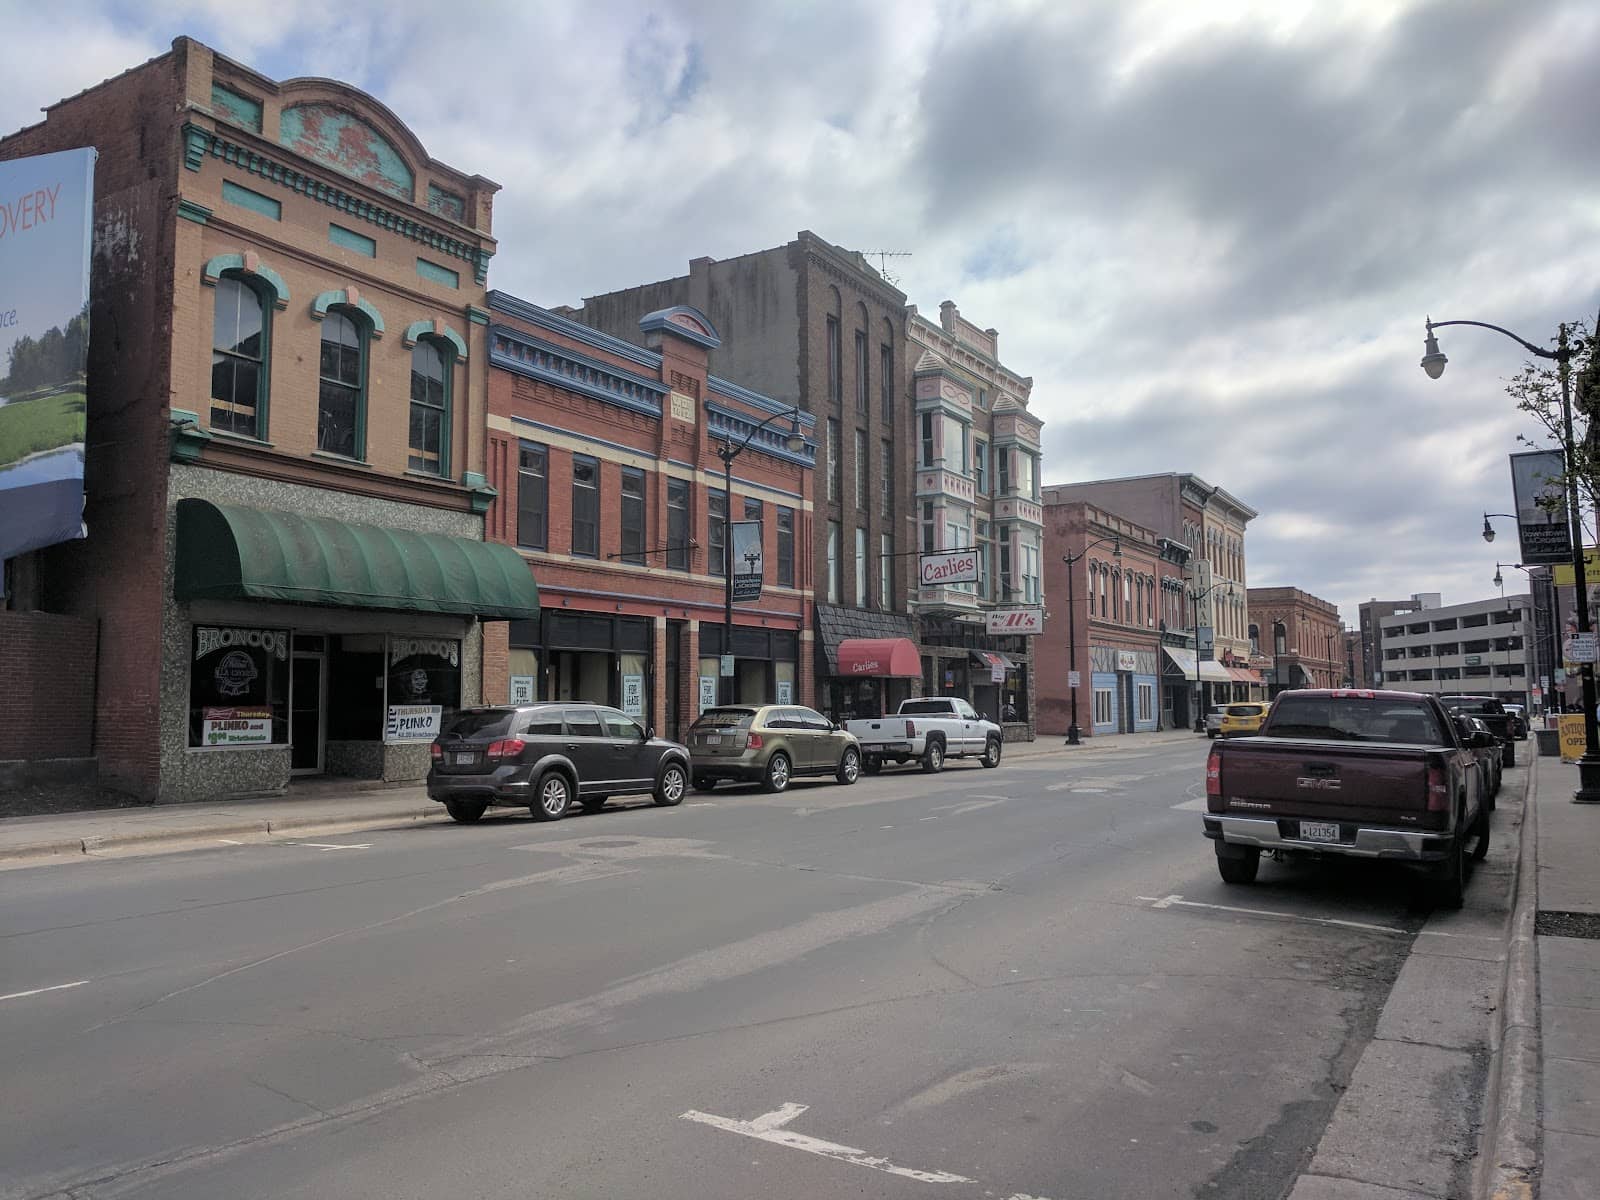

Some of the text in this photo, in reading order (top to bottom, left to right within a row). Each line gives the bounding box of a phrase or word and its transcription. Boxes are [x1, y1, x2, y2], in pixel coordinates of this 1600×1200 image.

[924, 557, 974, 582] Carlies
[195, 626, 288, 662] BRONCO'S
[391, 639, 459, 668] BRONCO'S
[852, 659, 879, 673] Carlies
[516, 686, 527, 698] FOR
[628, 684, 637, 695] FOR
[703, 685, 712, 695] FOR
[626, 695, 640, 706] LEASE
[702, 695, 713, 705] LEASE
[211, 720, 249, 731] PLINKO
[400, 716, 433, 730] PLINKO
[1566, 737, 1586, 746] OPE
[1296, 777, 1342, 790] GMC
